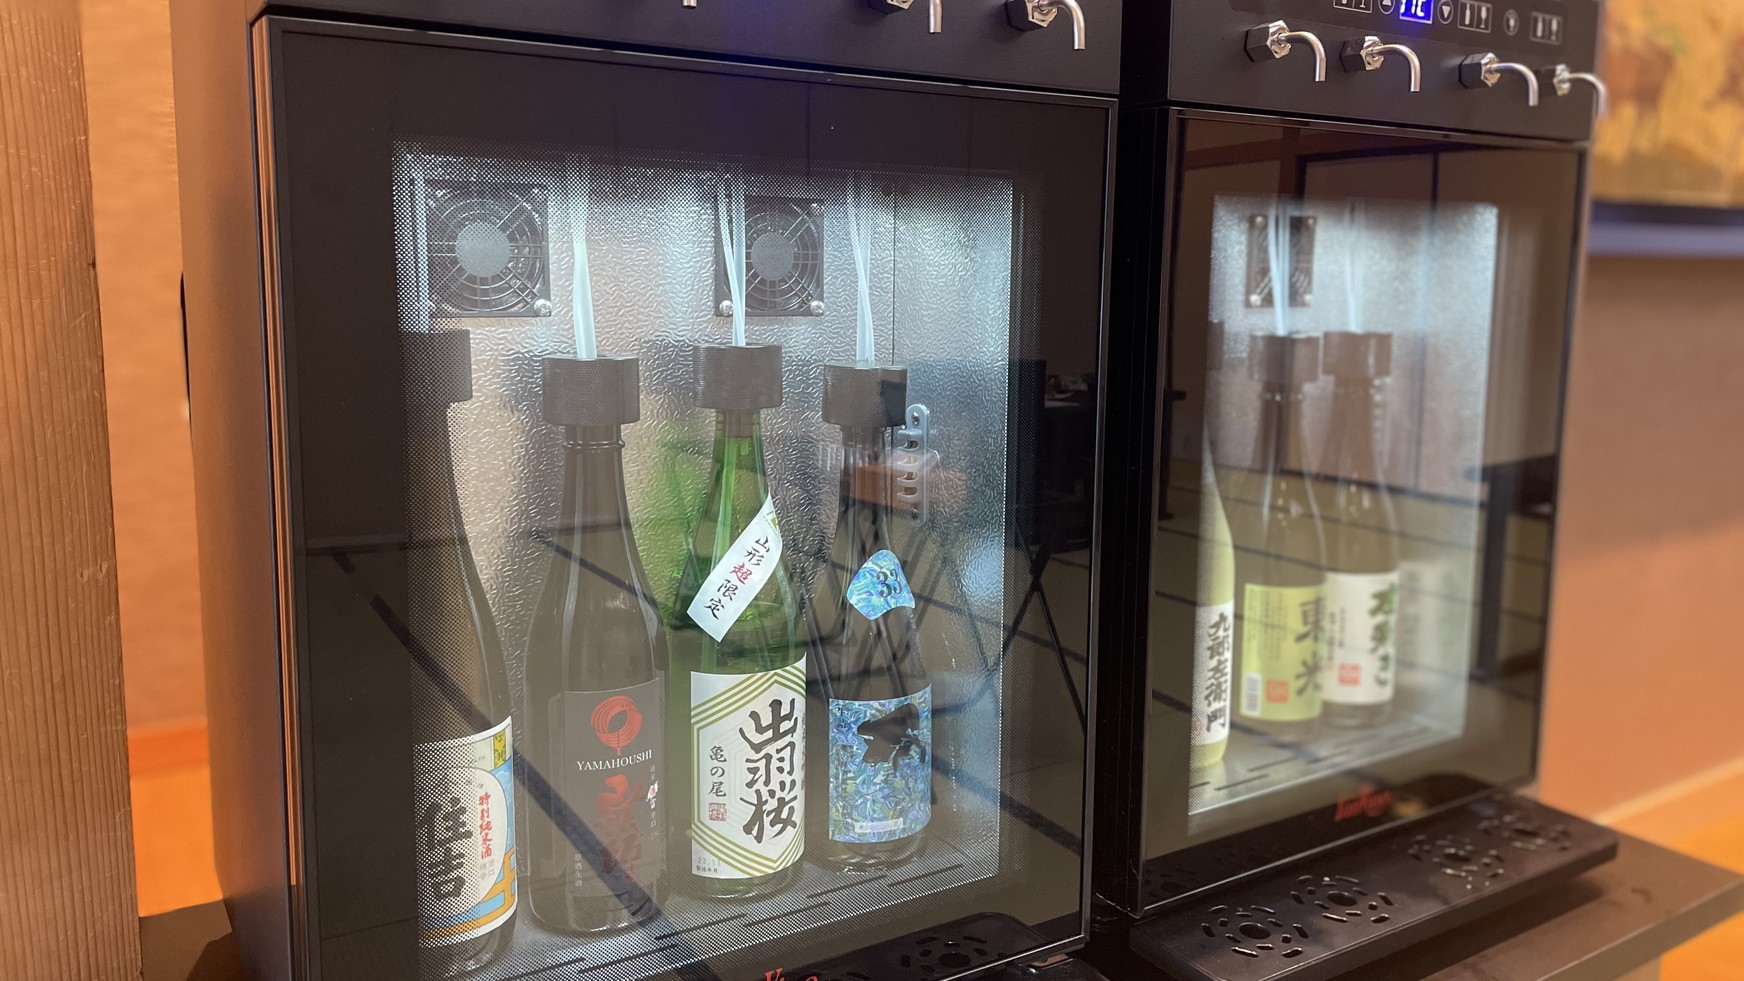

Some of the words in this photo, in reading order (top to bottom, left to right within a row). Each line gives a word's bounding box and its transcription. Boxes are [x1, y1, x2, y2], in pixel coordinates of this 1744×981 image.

[703, 536, 770, 620] 山形超限定
[876, 569, 902, 597] 33
[1204, 612, 1231, 732] 九郎左衛門
[1295, 597, 1323, 697] 東光
[576, 749, 652, 771] YAMAHOUSHI
[707, 745, 727, 797] 亀の尾
[739, 698, 798, 844] 出羽桜
[479, 791, 493, 860] 特別純米酒
